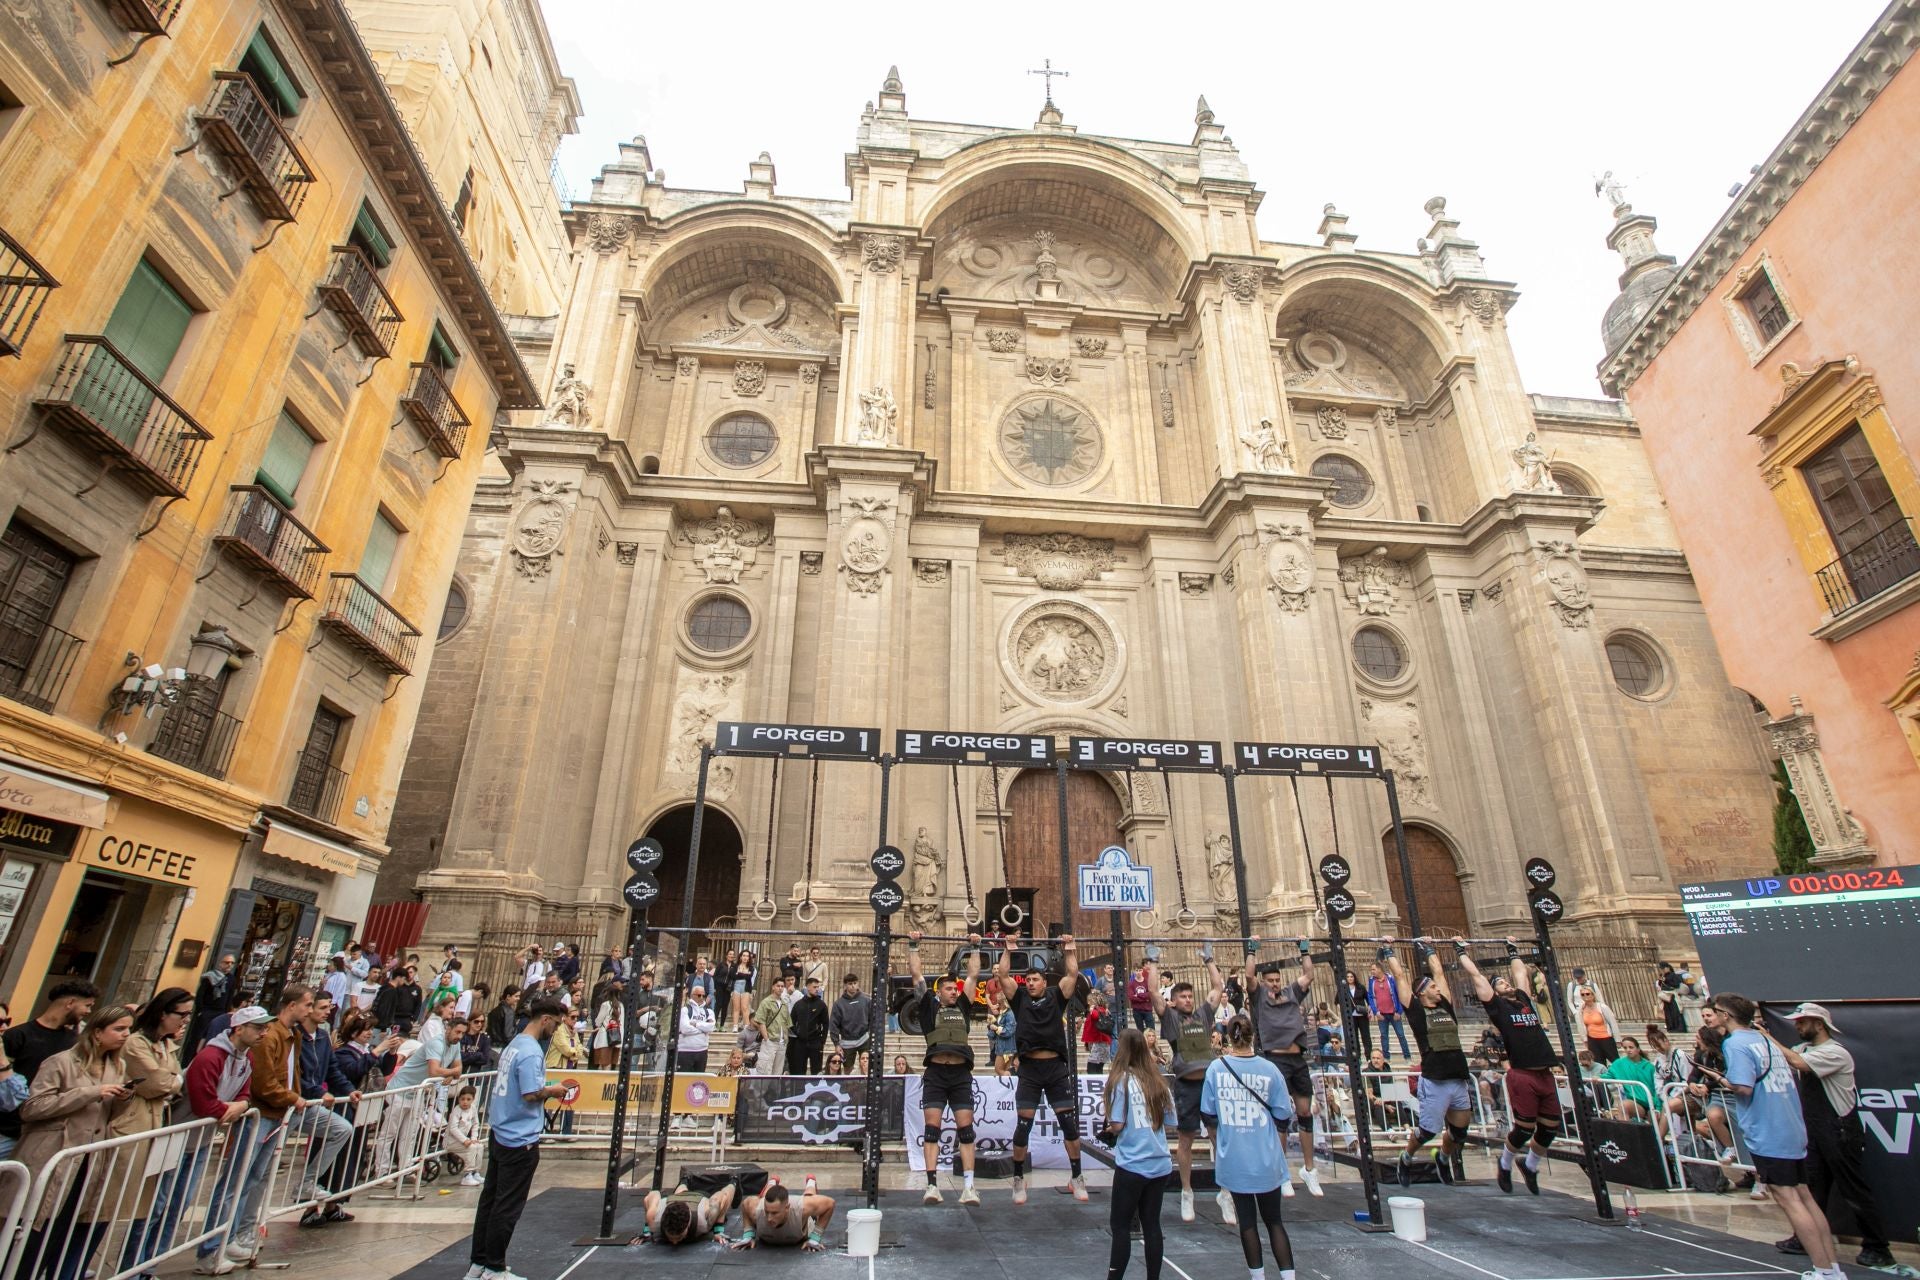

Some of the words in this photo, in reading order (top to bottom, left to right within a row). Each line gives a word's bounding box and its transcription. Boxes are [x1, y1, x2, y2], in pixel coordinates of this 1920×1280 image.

[730, 726, 739, 746] 1
[752, 727, 845, 743] FORGED
[859, 731, 868, 752] 1
[905, 733, 921, 754] 2
[931, 735, 1021, 749] FORGED
[1031, 738, 1047, 759] 2
[1078, 740, 1095, 760] 3
[1104, 741, 1189, 756] FORGED
[1198, 744, 1214, 764] 3
[1243, 746, 1260, 765] 4
[1267, 747, 1349, 760] FORGED
[1358, 749, 1374, 769] 4
[98, 835, 197, 881] COFFEE
[1682, 886, 1700, 894] WOD
[1746, 879, 1781, 896] UP
[1789, 869, 1905, 894] 00:00:24
[1086, 885, 1115, 901] THE
[1121, 885, 1146, 902] BOX
[1694, 892, 1733, 900] MASCULINO
[1216, 1072, 1238, 1088] I'M
[996, 1101, 1015, 1111] 2021
[1220, 1100, 1268, 1127] REPS
[1599, 1147, 1628, 1157] FORGED
